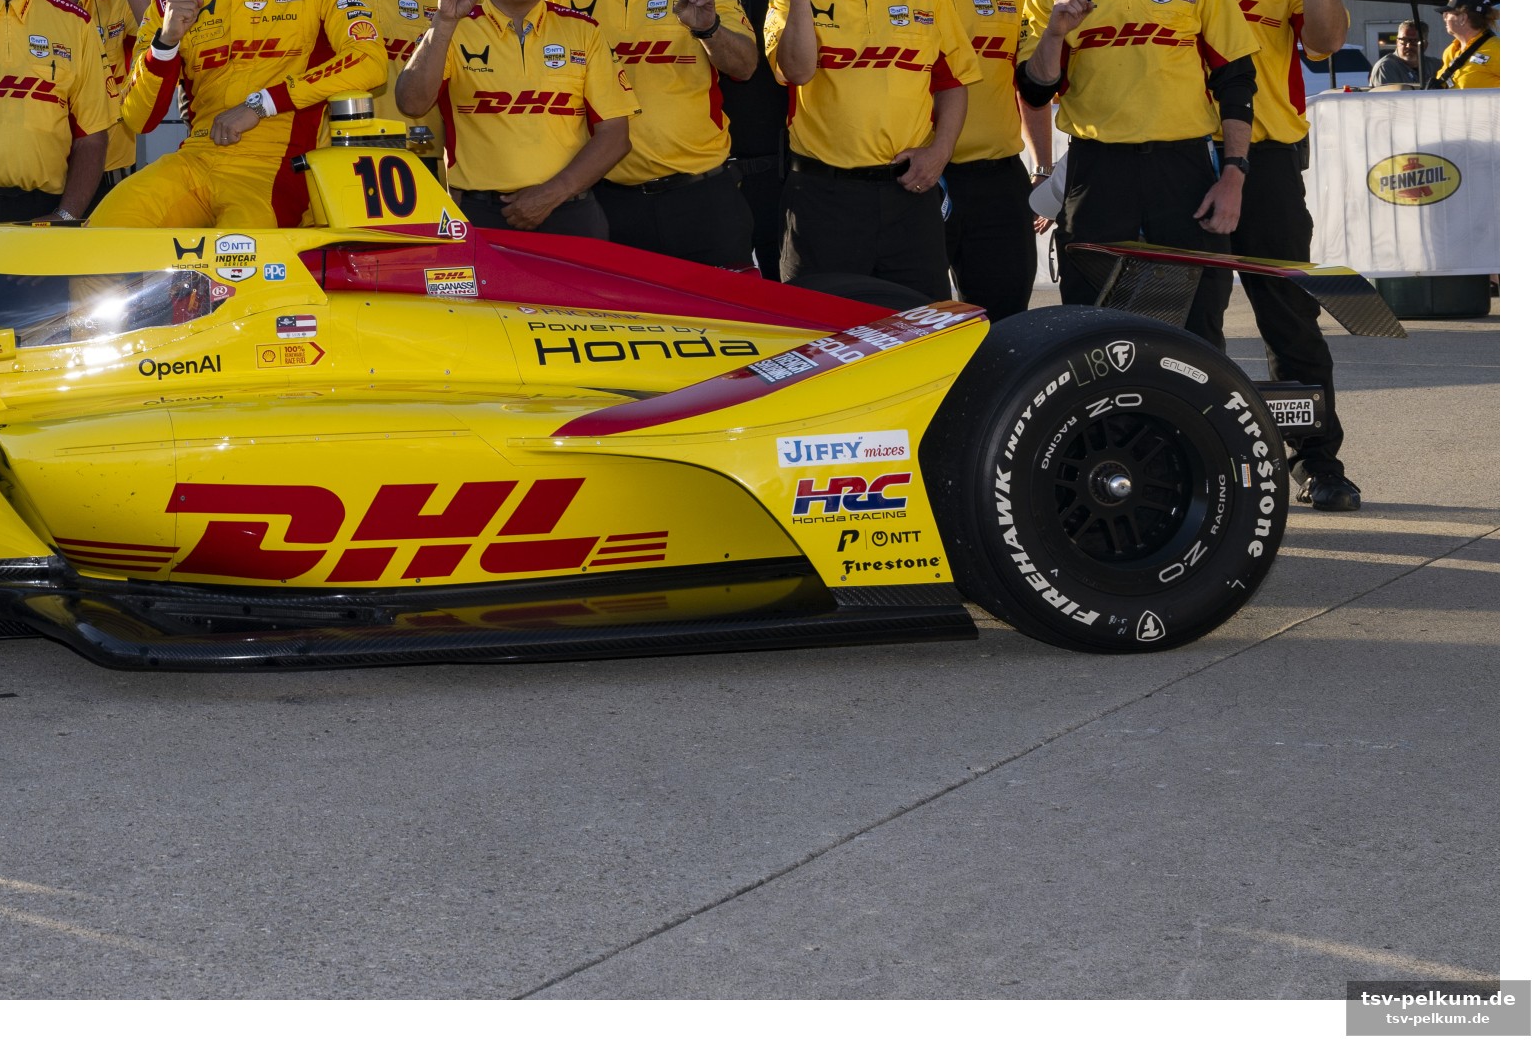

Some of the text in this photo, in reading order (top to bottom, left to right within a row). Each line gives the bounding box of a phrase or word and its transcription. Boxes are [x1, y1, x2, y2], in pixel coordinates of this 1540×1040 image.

[270, 14, 298, 22] PALOU
[1078, 22, 1180, 48] DHL
[199, 38, 286, 70] DHL
[614, 41, 678, 64] HL
[820, 46, 927, 72] DHL
[303, 53, 362, 84] DHL
[473, 90, 576, 116] DHL
[353, 155, 418, 218] 10
[1379, 166, 1448, 192] PENNZOIL
[216, 254, 256, 262] INDYCAR
[232, 242, 252, 250] NTT
[264, 264, 284, 279] PPG
[434, 272, 467, 280] DHL
[438, 282, 474, 290] GANASSI
[528, 322, 706, 334] Powered by
[534, 336, 760, 366] Honda
[138, 355, 222, 380] OpenAI
[1162, 358, 1207, 383] ENLITEN
[1268, 401, 1310, 410] NDYCAR
[1276, 411, 1312, 424] BRID
[864, 444, 905, 458] mixes
[1041, 416, 1078, 470] RACING
[1225, 391, 1278, 558] Firestone
[792, 472, 912, 515] HRC
[1210, 474, 1226, 536] RACING
[792, 510, 906, 524] Honda RACING
[165, 478, 602, 583] DHL
[890, 530, 922, 544] NTT
[996, 466, 1100, 626] FIREHAWK
[842, 556, 940, 575] Firestone
